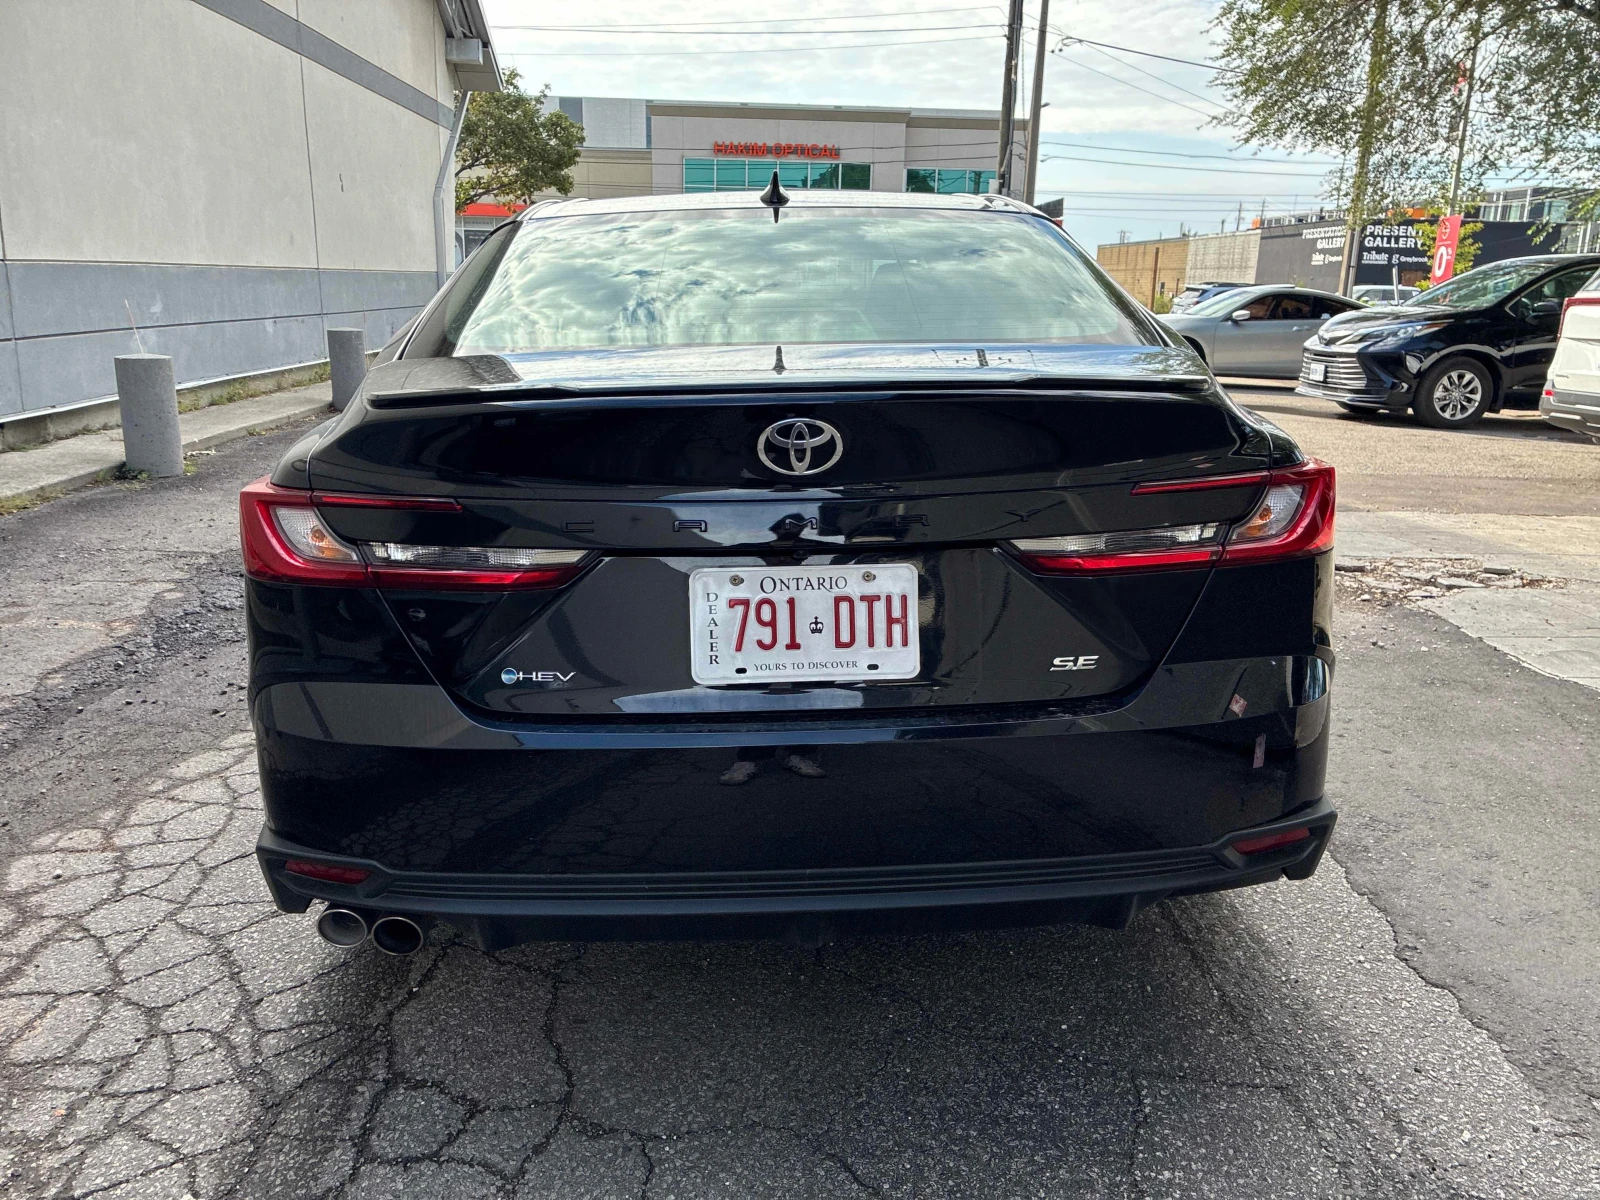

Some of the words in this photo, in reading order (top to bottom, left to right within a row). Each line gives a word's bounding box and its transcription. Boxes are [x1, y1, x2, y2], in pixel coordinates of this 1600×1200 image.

[713, 141, 767, 156] HAKIM
[771, 142, 840, 159] OPTICAL
[1317, 237, 1346, 249] GALLERY
[1364, 236, 1423, 248] GALLERY
[1362, 250, 1389, 260] Tribute
[560, 508, 1041, 533] CAMRY
[759, 576, 848, 594] ONTARIO
[705, 592, 720, 665] DEALER
[727, 596, 802, 652] 791
[833, 594, 909, 649] DTH
[753, 663, 787, 672] YOURS
[790, 662, 805, 671] TO
[808, 660, 858, 671] DISCOVER
[1048, 655, 1100, 672] SE
[519, 671, 577, 682] HEV
